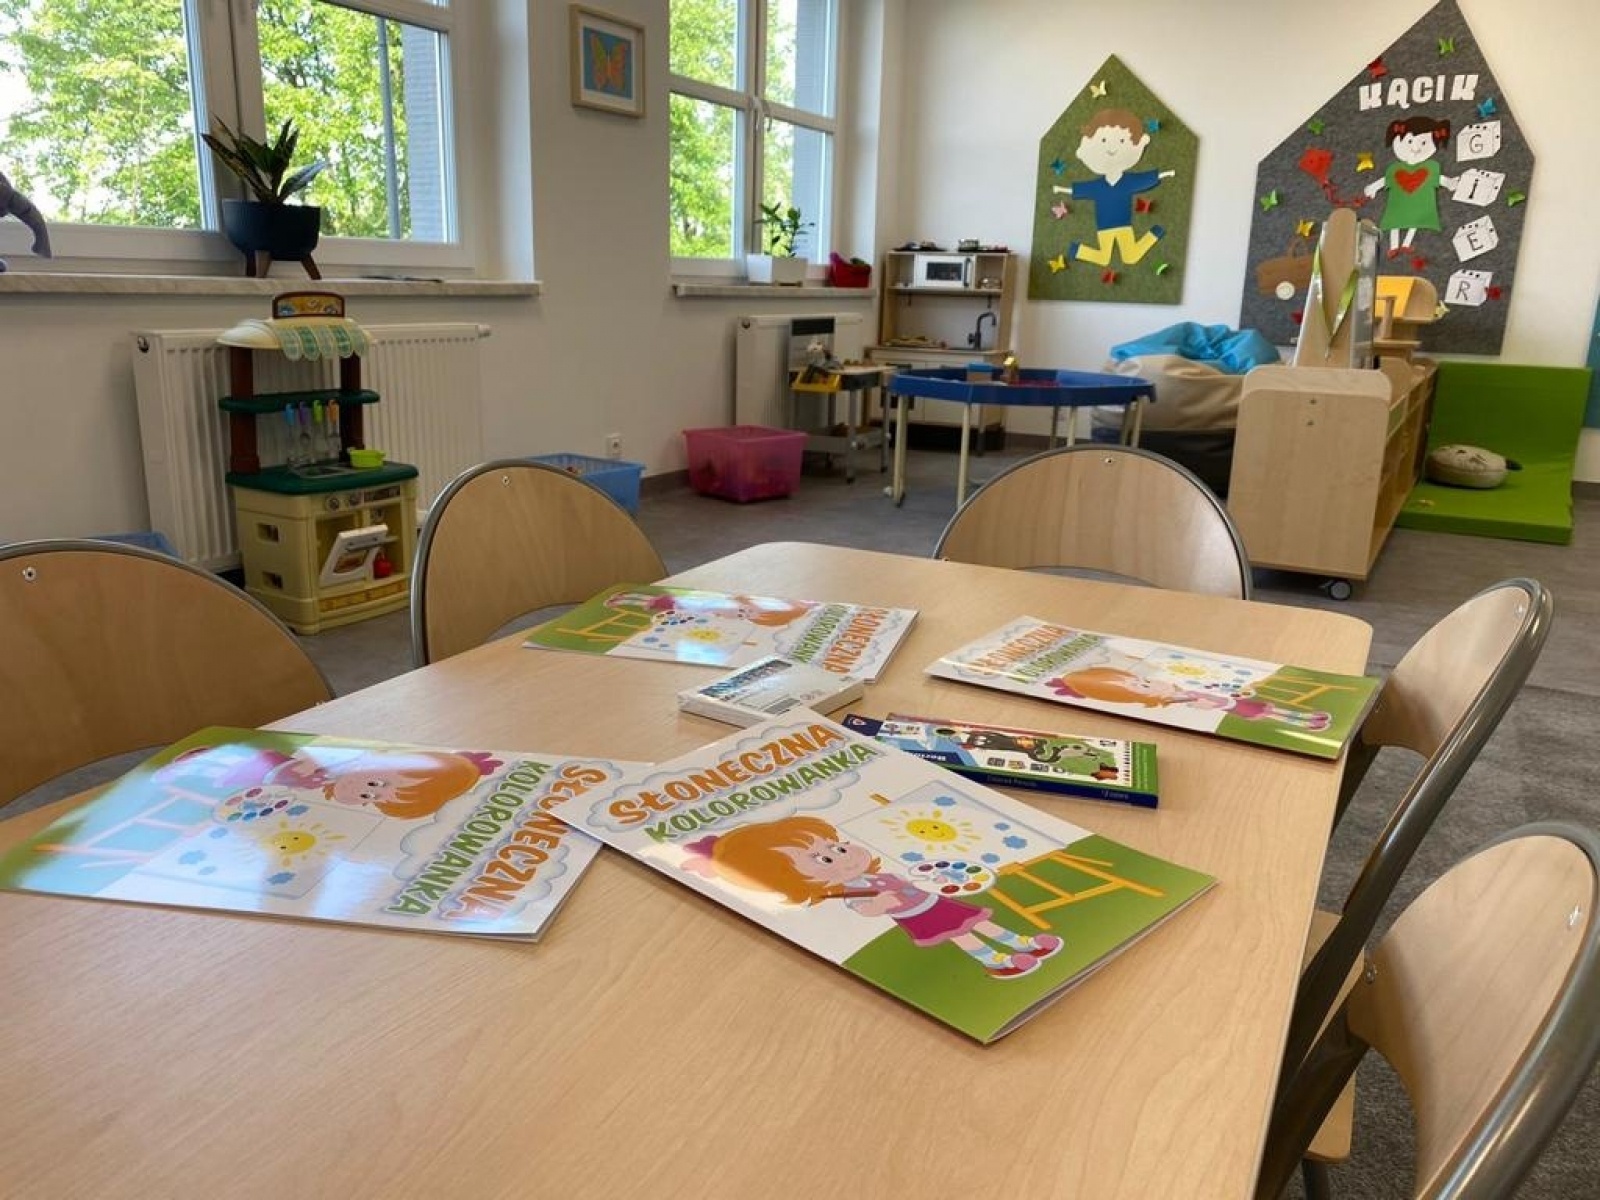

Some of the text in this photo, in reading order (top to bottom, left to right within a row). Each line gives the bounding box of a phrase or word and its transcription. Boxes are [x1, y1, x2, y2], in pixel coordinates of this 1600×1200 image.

[1359, 75, 1478, 110] KĄCIK
[608, 724, 845, 824] SŁONECZNA
[645, 743, 877, 843] KOLOROWANKA
[388, 760, 551, 915] KOLOROWANKA
